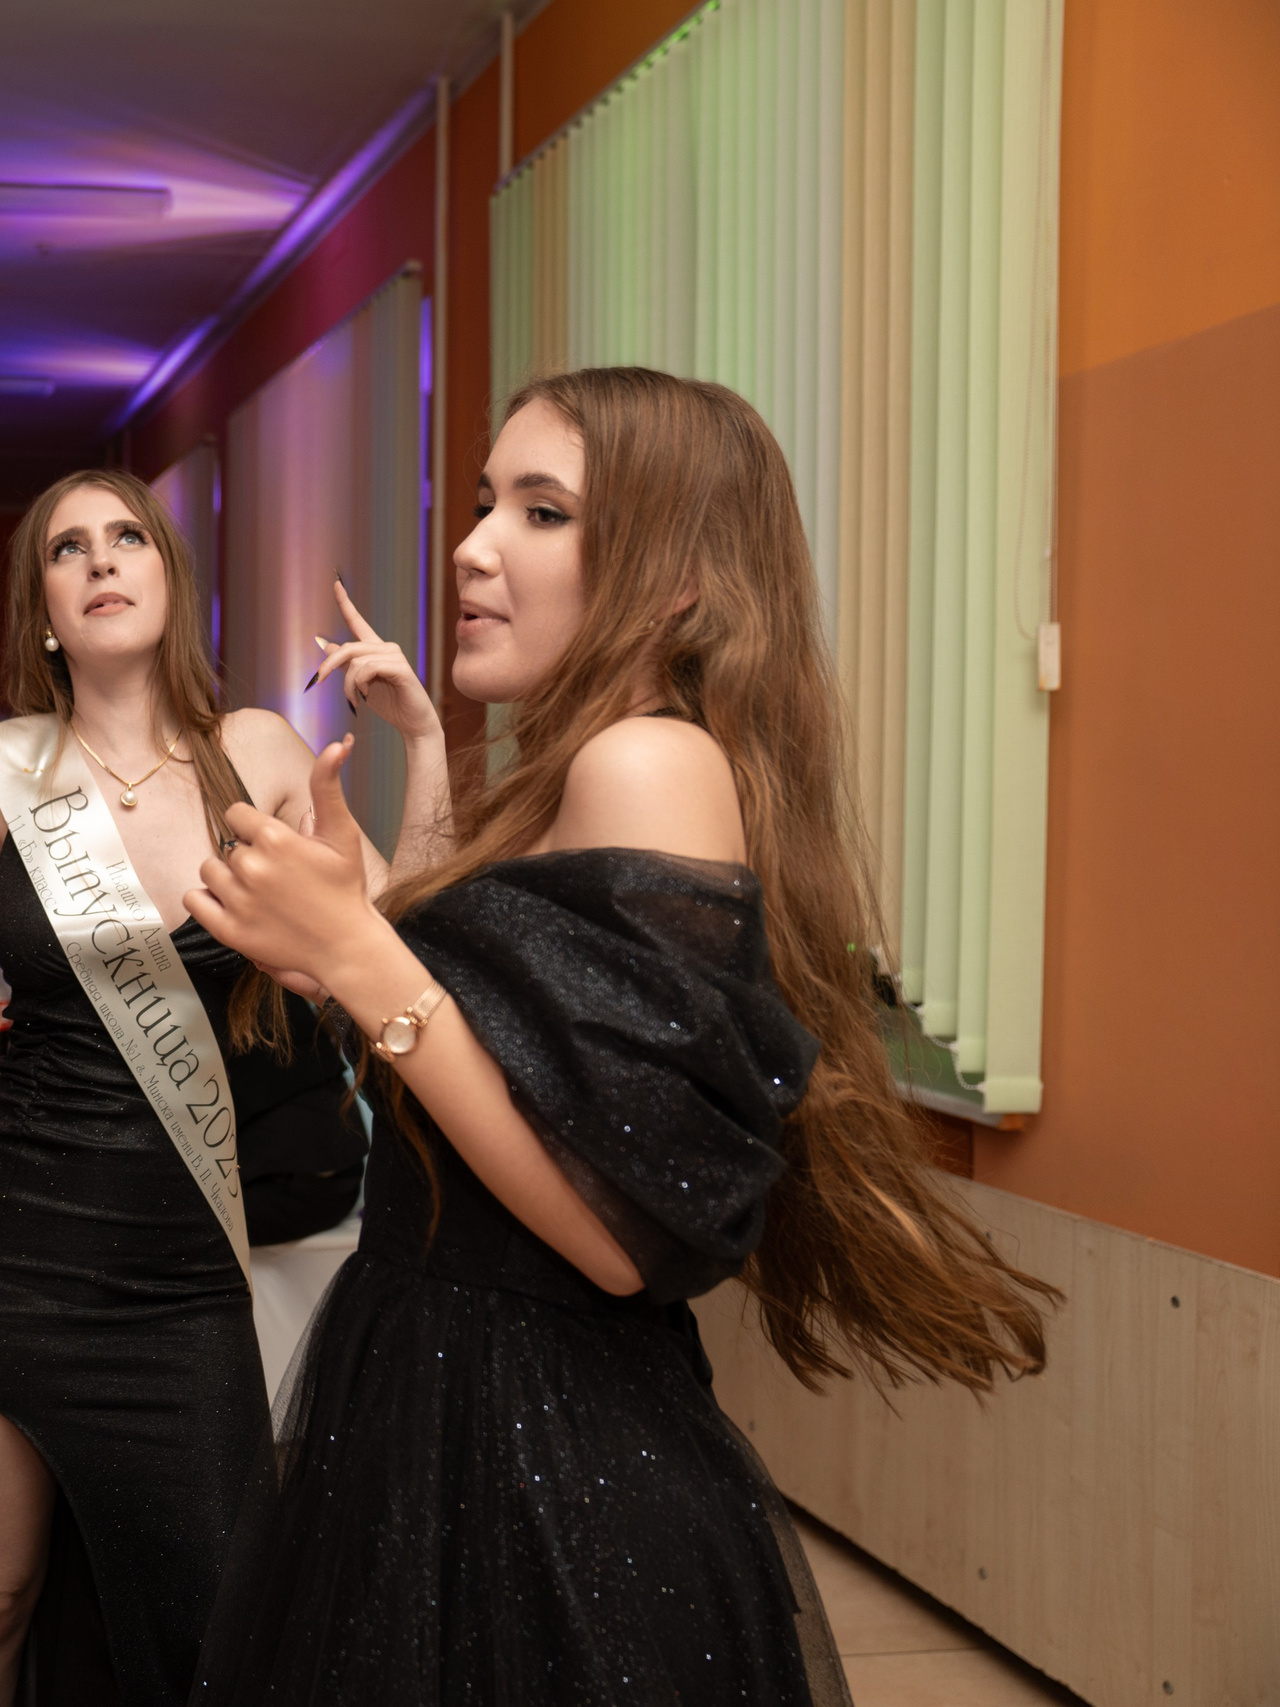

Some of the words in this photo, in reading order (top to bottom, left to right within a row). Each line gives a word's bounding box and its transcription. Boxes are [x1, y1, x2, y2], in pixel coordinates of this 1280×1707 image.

[7, 815, 25, 833] 11
[29, 866, 56, 908] класс
[66, 942, 102, 1002] Средняя
[100, 1003, 125, 1040] школа
[121, 1039, 141, 1062] №1
[144, 1075, 174, 1121] Минска
[170, 1121, 194, 1157] имени
[211, 1182, 234, 1231] Чкалова
[28, 786, 199, 1091] Выпускница
[140, 927, 172, 973] Алина
